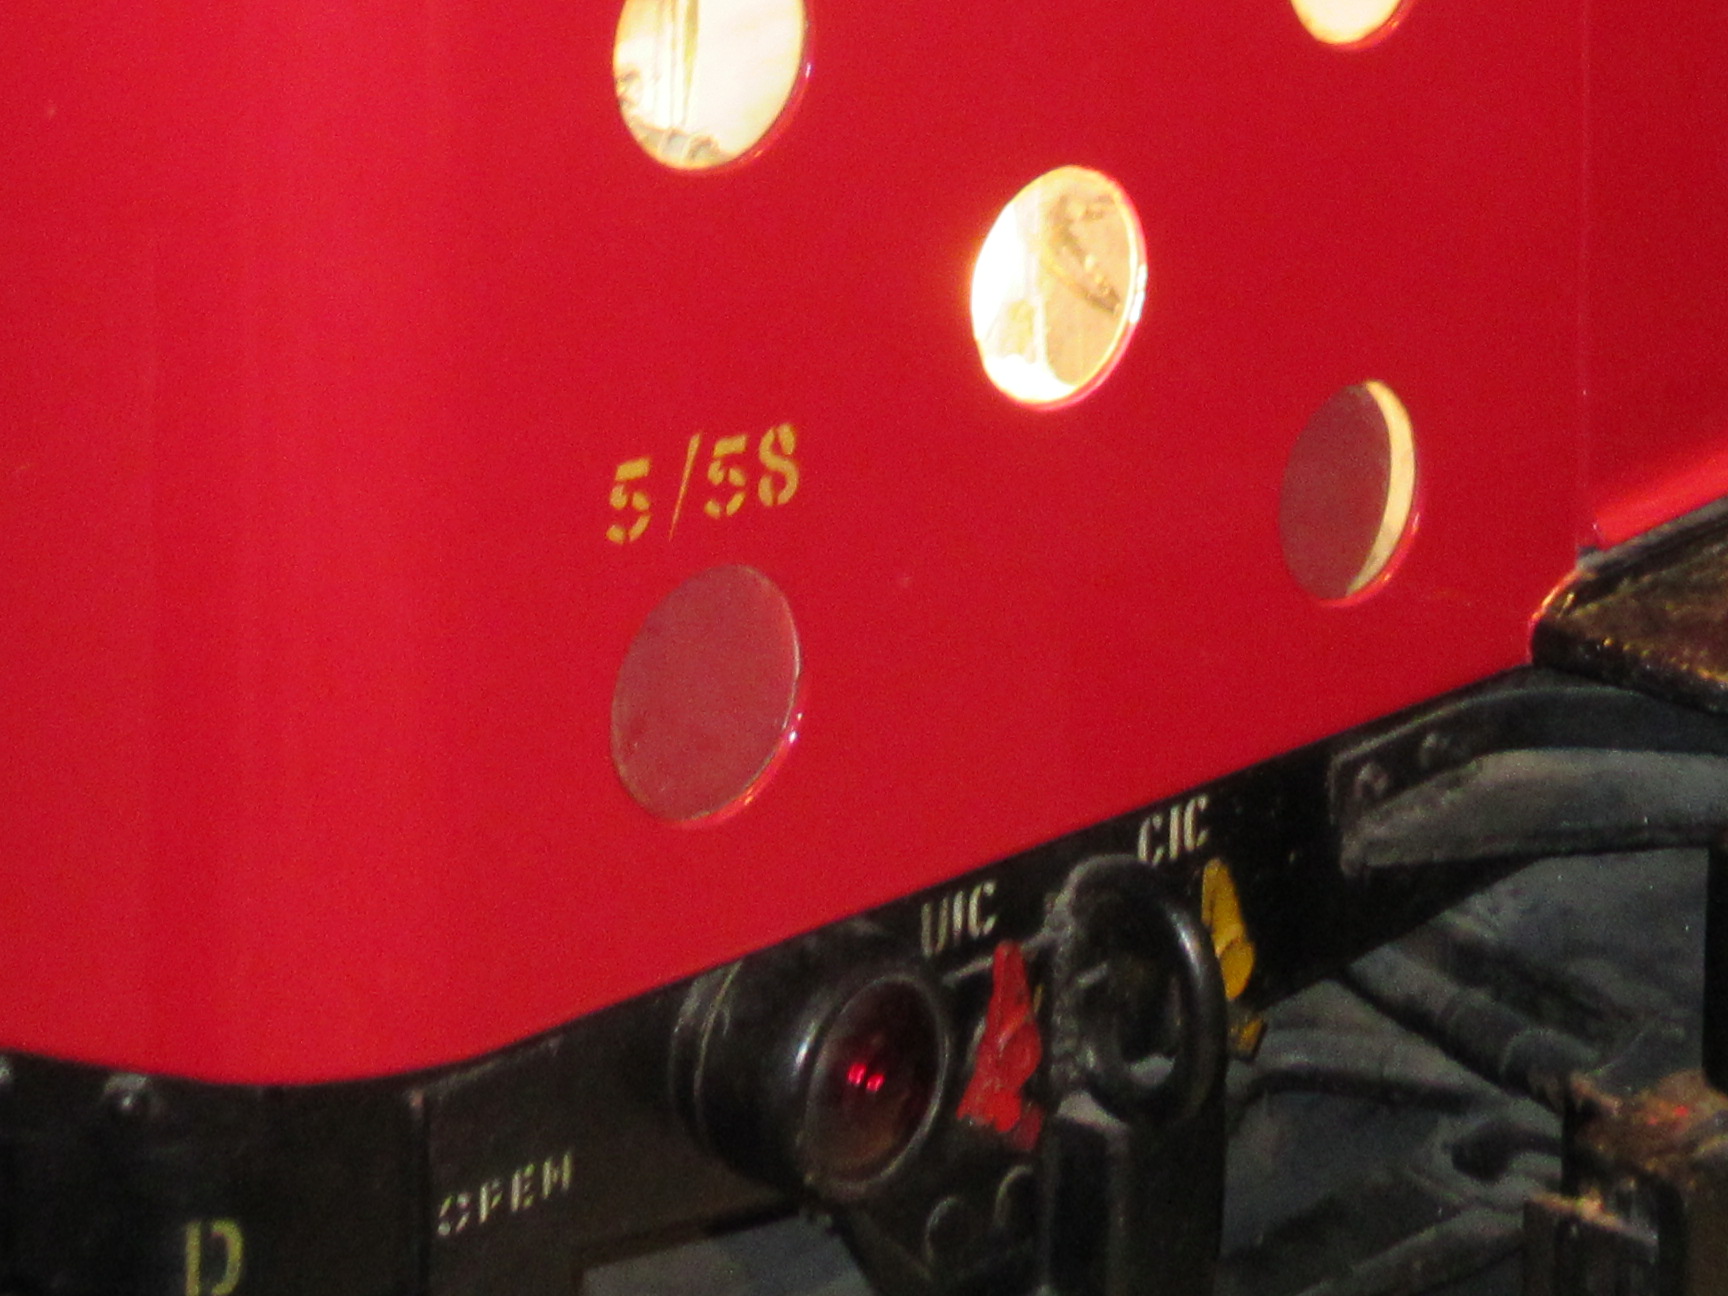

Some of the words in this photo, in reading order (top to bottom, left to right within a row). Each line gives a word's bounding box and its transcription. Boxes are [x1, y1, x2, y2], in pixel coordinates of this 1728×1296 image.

[1136, 793, 1211, 868] CIC
[919, 878, 998, 959] UIC
[185, 1218, 244, 1296] D
